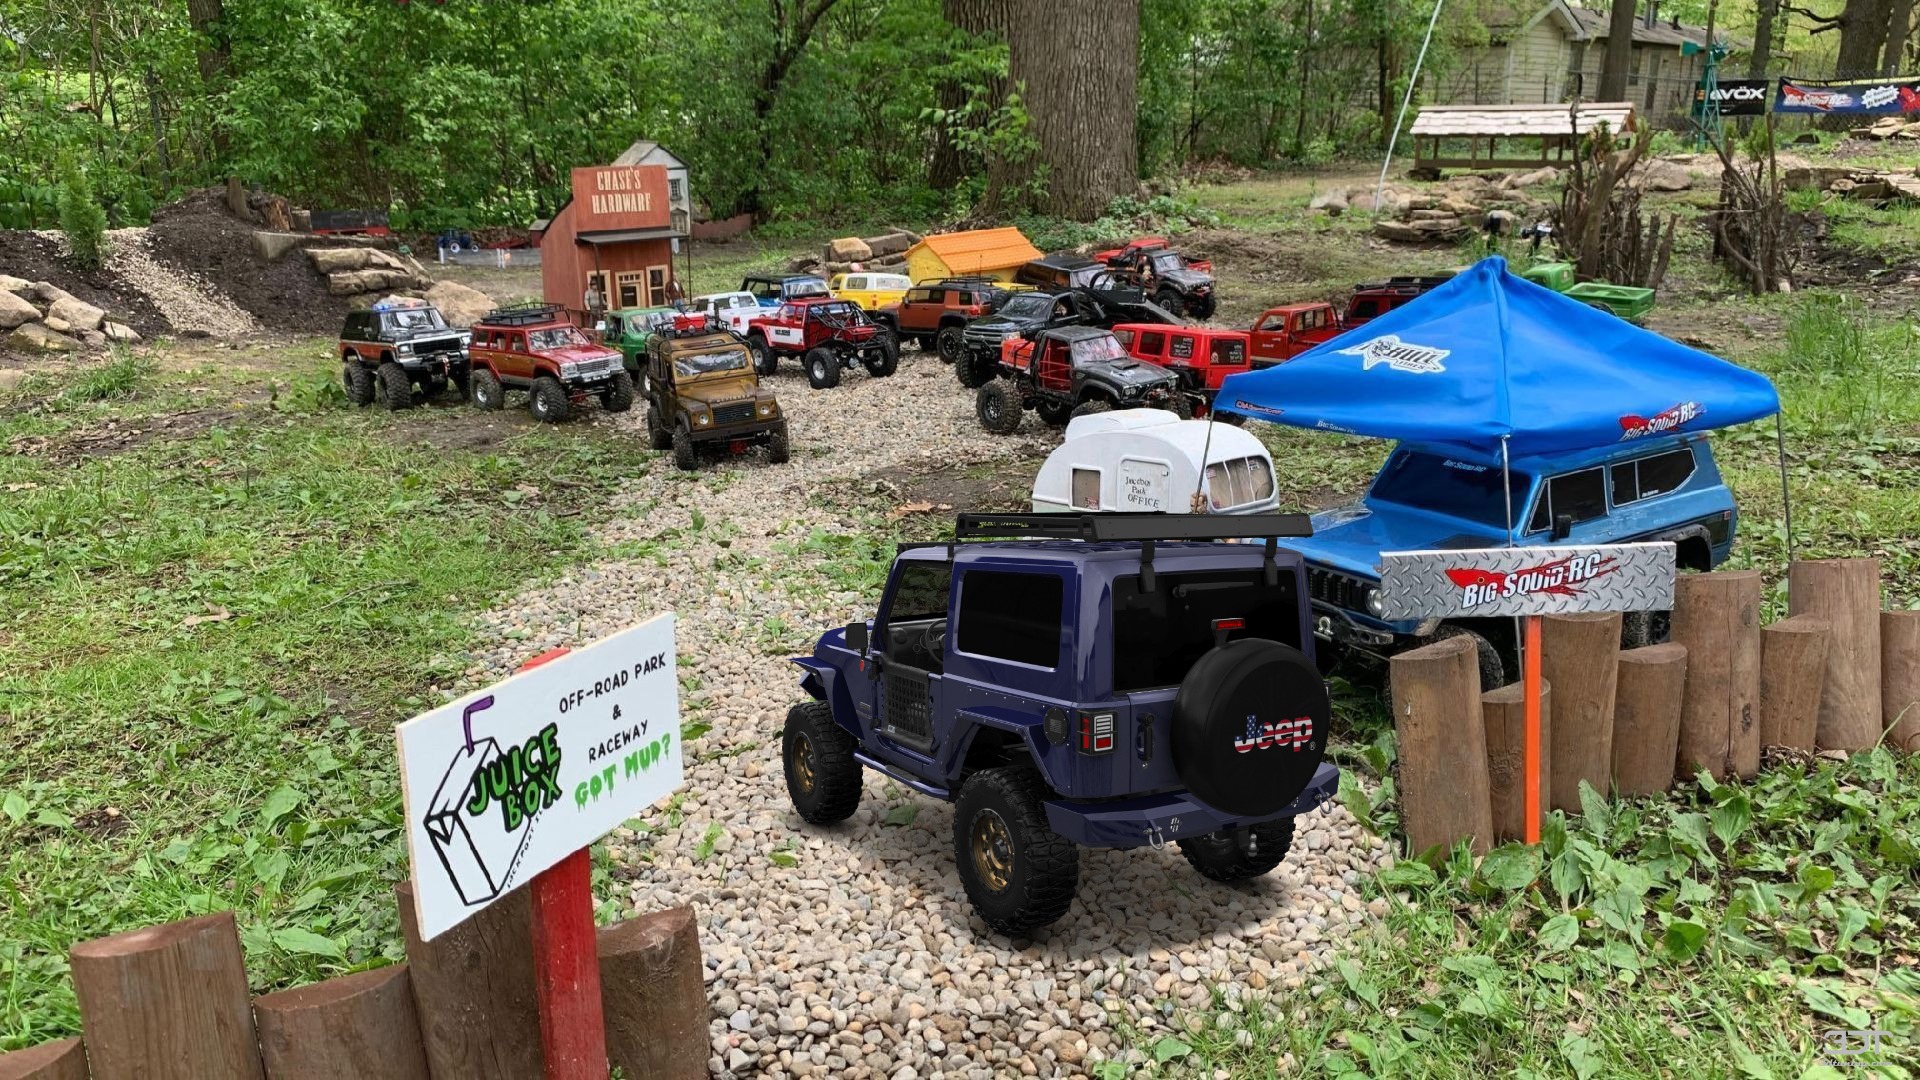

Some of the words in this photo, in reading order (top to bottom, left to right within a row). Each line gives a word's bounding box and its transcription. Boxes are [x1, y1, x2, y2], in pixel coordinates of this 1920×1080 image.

[596, 165, 641, 191] CHASE'S
[591, 192, 651, 214] HARDWARE
[1619, 426, 1645, 441] BIG
[1643, 409, 1679, 436] SQUID
[1680, 401, 1695, 424] RC
[1127, 493, 1160, 508] OFFICE
[1131, 486, 1146, 495] Park
[1461, 582, 1498, 609] BIG
[1502, 566, 1565, 599] SQUID
[1567, 553, 1601, 584] RC
[559, 670, 628, 713] OFF-ROAD
[634, 652, 666, 679] PARK
[612, 704, 622, 720] &
[588, 719, 648, 764] RACEWAY
[466, 722, 561, 817] JUICE
[574, 763, 617, 813] GOT
[624, 732, 671, 782] MUD?
[501, 764, 563, 833] BOX
